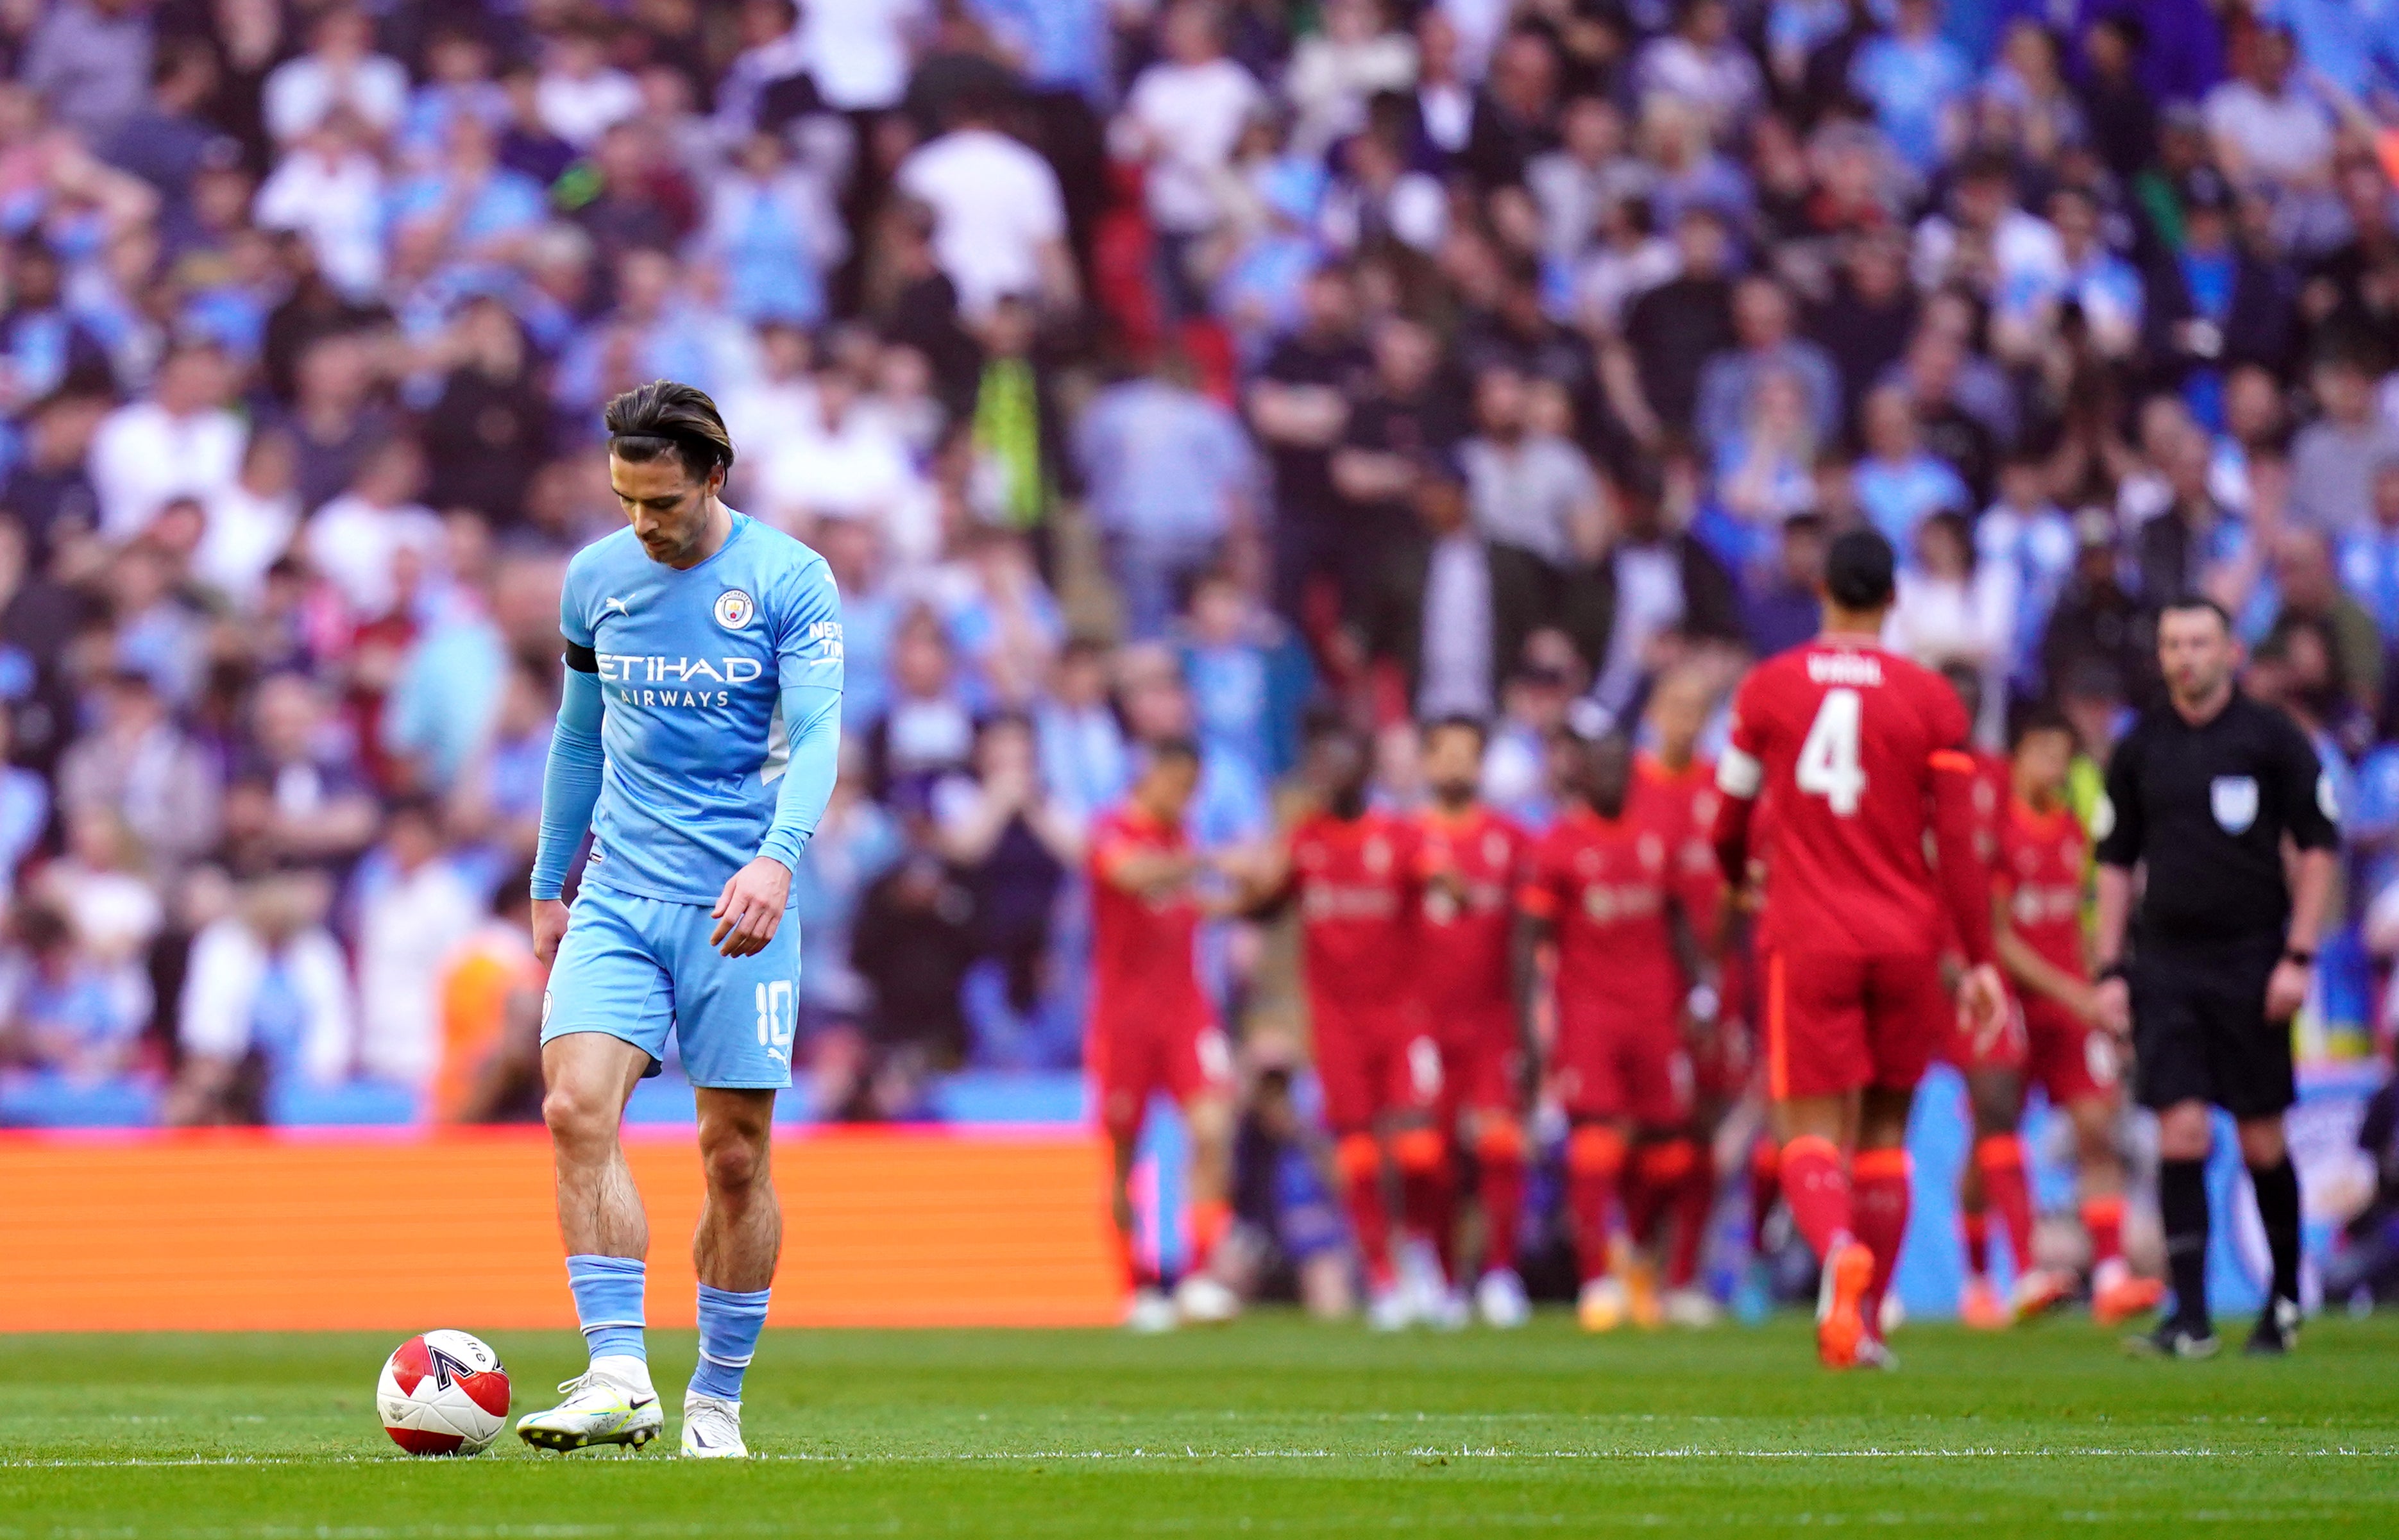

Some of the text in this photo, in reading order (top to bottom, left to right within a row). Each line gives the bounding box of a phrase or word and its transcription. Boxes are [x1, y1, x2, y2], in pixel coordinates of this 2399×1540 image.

[819, 639, 843, 657] TIR
[598, 654, 762, 682] ETIHAD
[621, 690, 729, 707] AIRWAYS
[1795, 688, 1867, 818] 4
[756, 980, 792, 1046] 10
